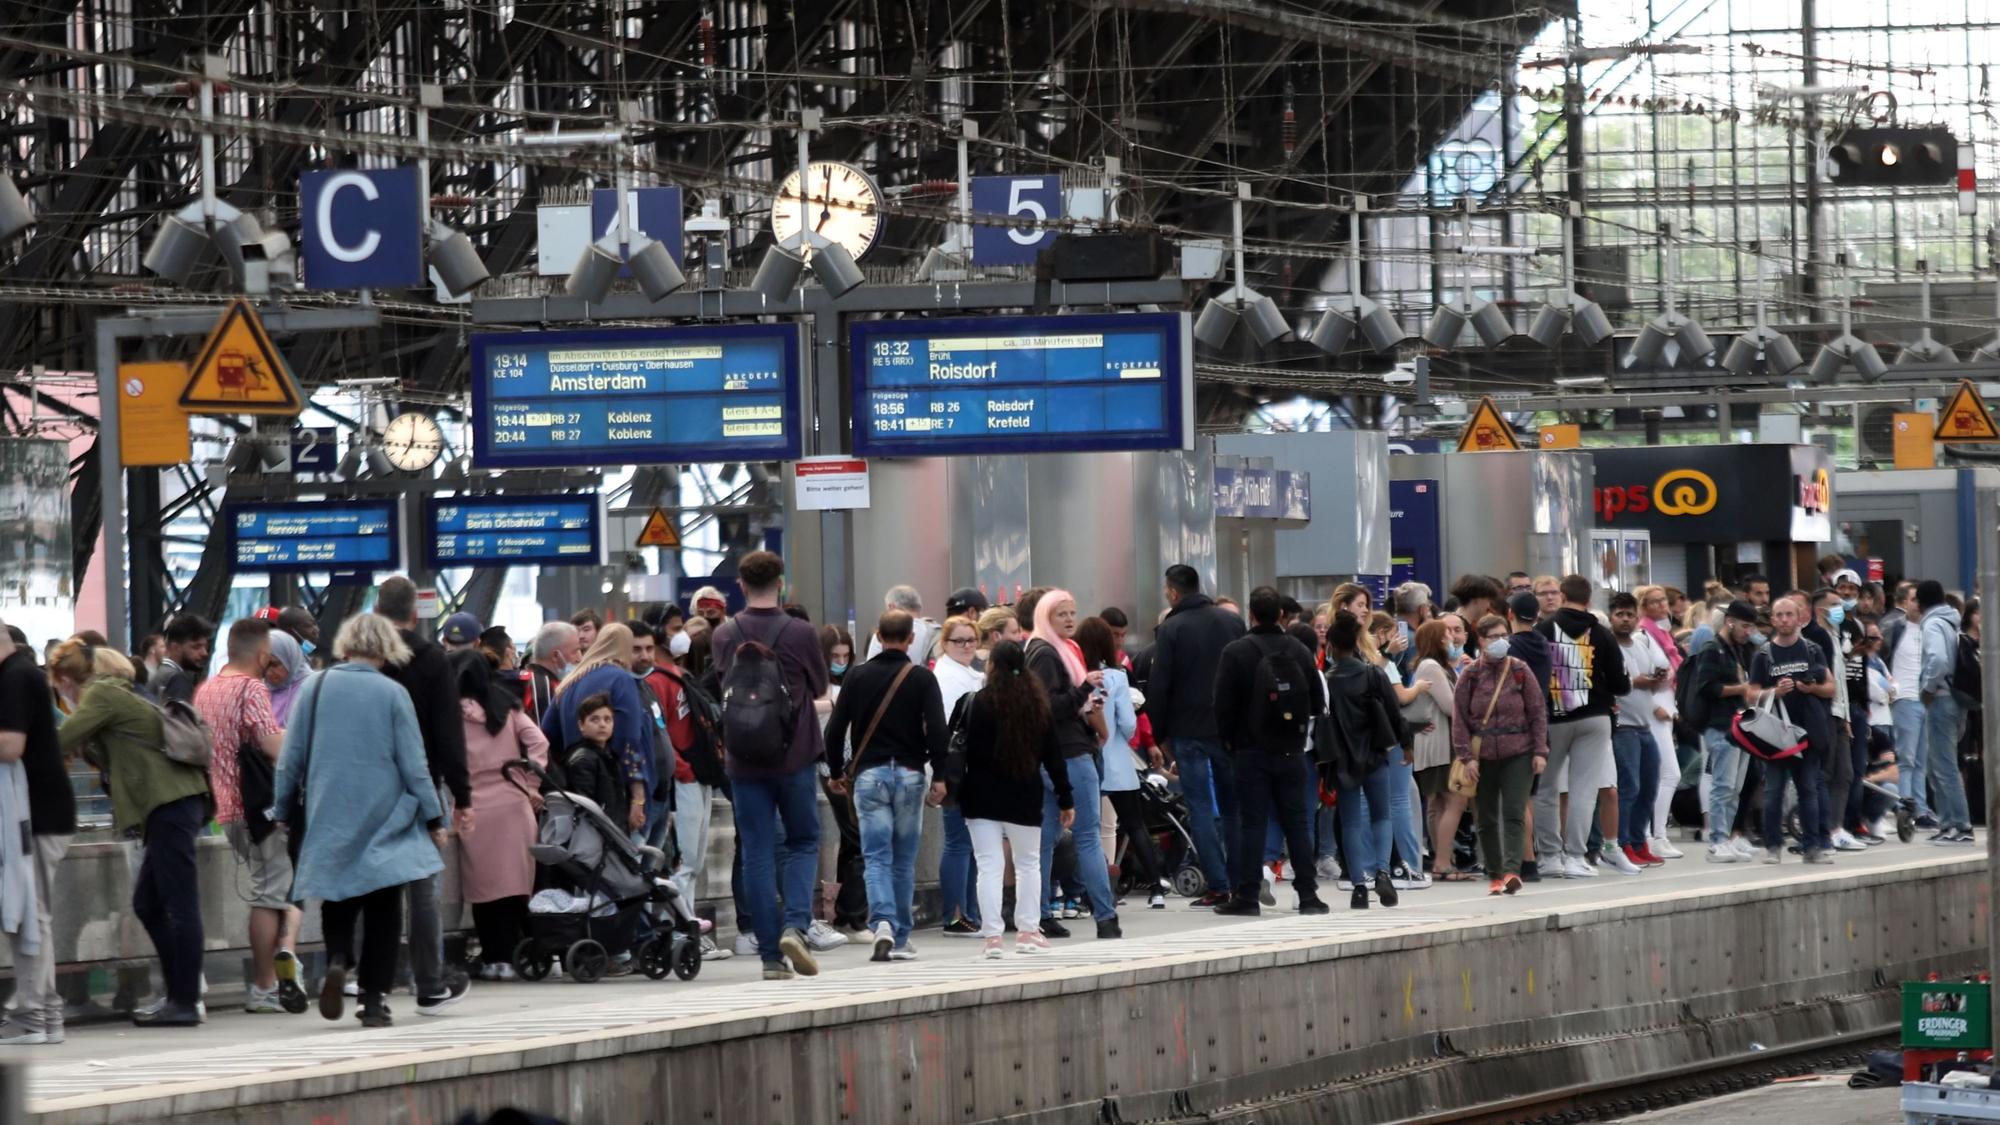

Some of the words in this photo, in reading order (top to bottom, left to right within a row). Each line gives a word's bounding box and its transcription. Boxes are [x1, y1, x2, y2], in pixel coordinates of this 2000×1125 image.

[316, 171, 382, 263] C
[1008, 179, 1047, 246] 5
[873, 341, 910, 356] 18:32
[930, 351, 951, 361] Brühl
[494, 353, 528, 368] 19:14
[550, 362, 594, 373] Düsseldorf
[602, 361, 638, 372] Duisburg
[645, 360, 694, 370] Oberhausen
[873, 357, 883, 367] RE
[885, 357, 890, 366] 5
[892, 356, 914, 366] (RRX)
[493, 369, 507, 379] ICE
[509, 368, 523, 378] 104
[930, 361, 997, 380] Roisdorf
[550, 373, 646, 392] Amsterdam
[873, 403, 905, 415] 18:56
[930, 402, 945, 413] RB
[947, 402, 960, 412] 26
[988, 399, 1034, 412] Roisdorf
[495, 414, 525, 427] 19:44
[552, 414, 565, 425] RB
[568, 413, 581, 424] 27
[608, 412, 652, 424] Koblenz
[874, 419, 905, 431] 18:41
[931, 418, 944, 429] RE
[947, 418, 954, 428] 7
[988, 416, 1030, 428] Krefeld
[495, 431, 526, 443] 20:44
[552, 430, 565, 441] RB
[568, 430, 581, 441] 27
[608, 428, 652, 440] Koblenz
[297, 428, 319, 463] 2
[266, 525, 308, 535] Hannover
[466, 519, 492, 529] Berlin
[494, 517, 545, 528] Ostbahnhof
[1918, 1017, 1968, 1033] ERDINGER
